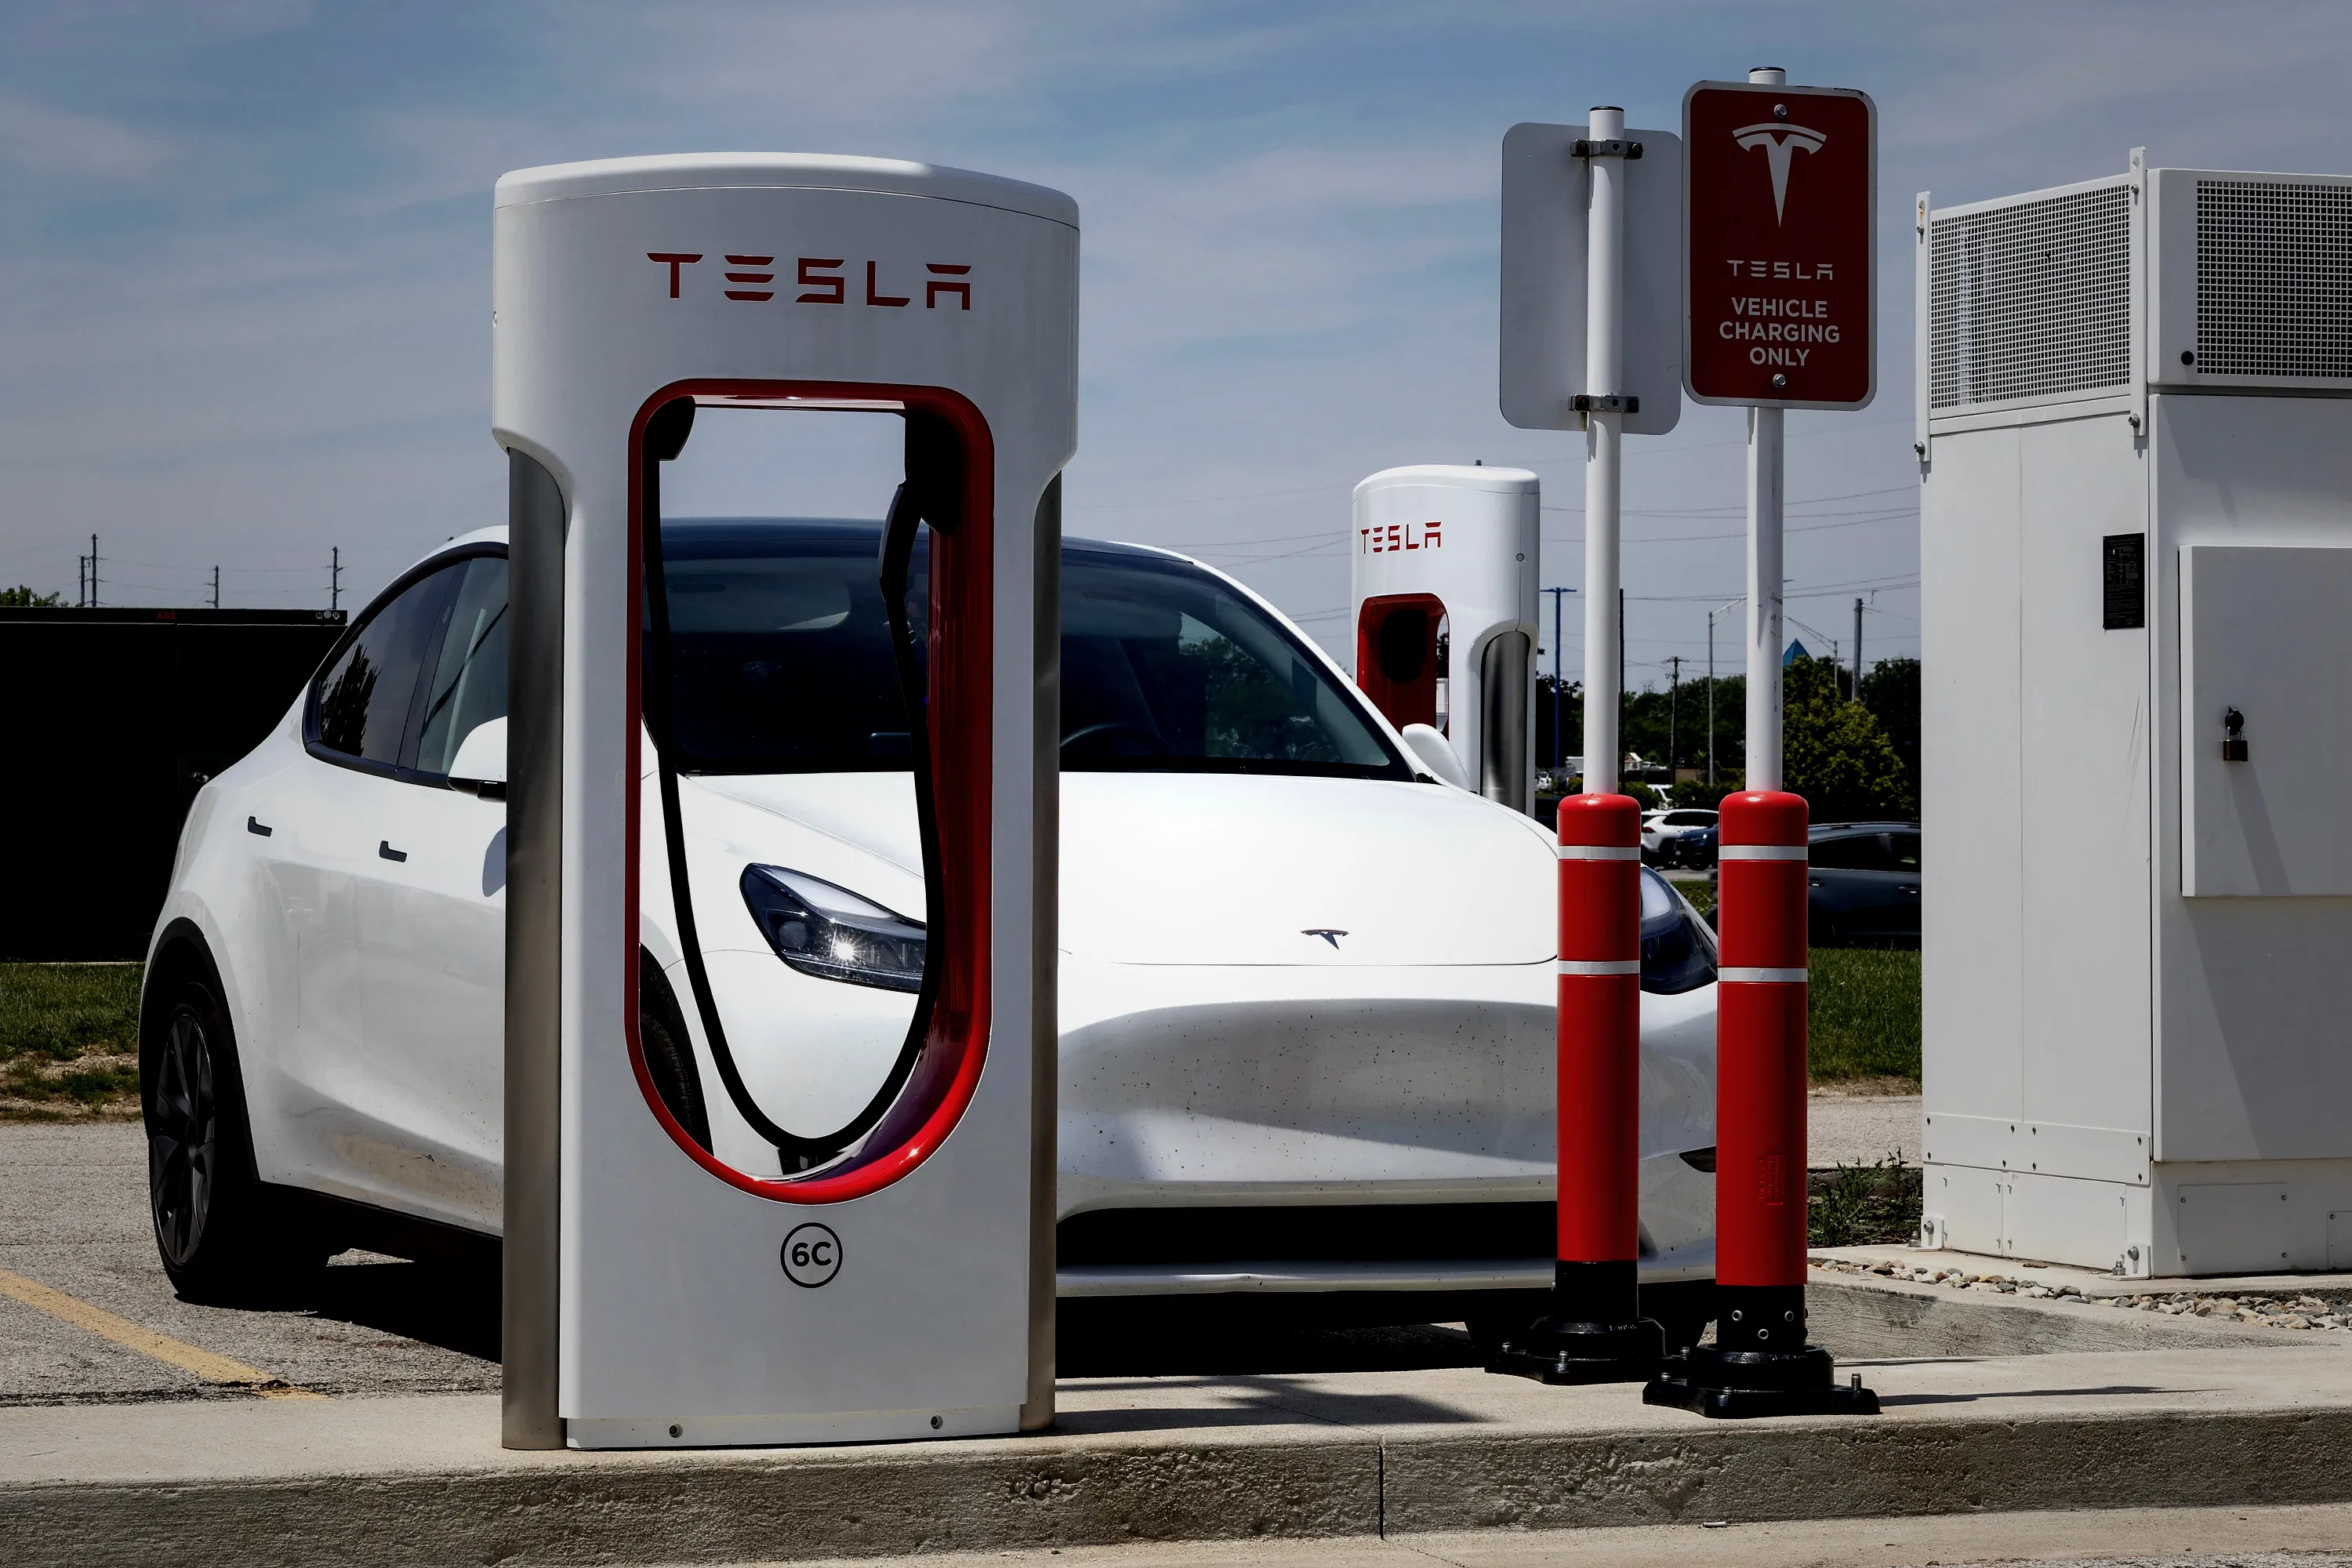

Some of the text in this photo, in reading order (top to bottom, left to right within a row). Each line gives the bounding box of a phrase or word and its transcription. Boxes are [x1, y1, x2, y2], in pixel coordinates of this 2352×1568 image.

[647, 252, 971, 310] TESLA
[1726, 260, 1834, 281] TESLA
[1731, 297, 1828, 318] VEHICLE
[1719, 321, 1840, 343] CHARGING
[1749, 347, 1810, 367] ONLY
[1360, 521, 1442, 555] TESLA
[791, 1241, 833, 1267] 6C
